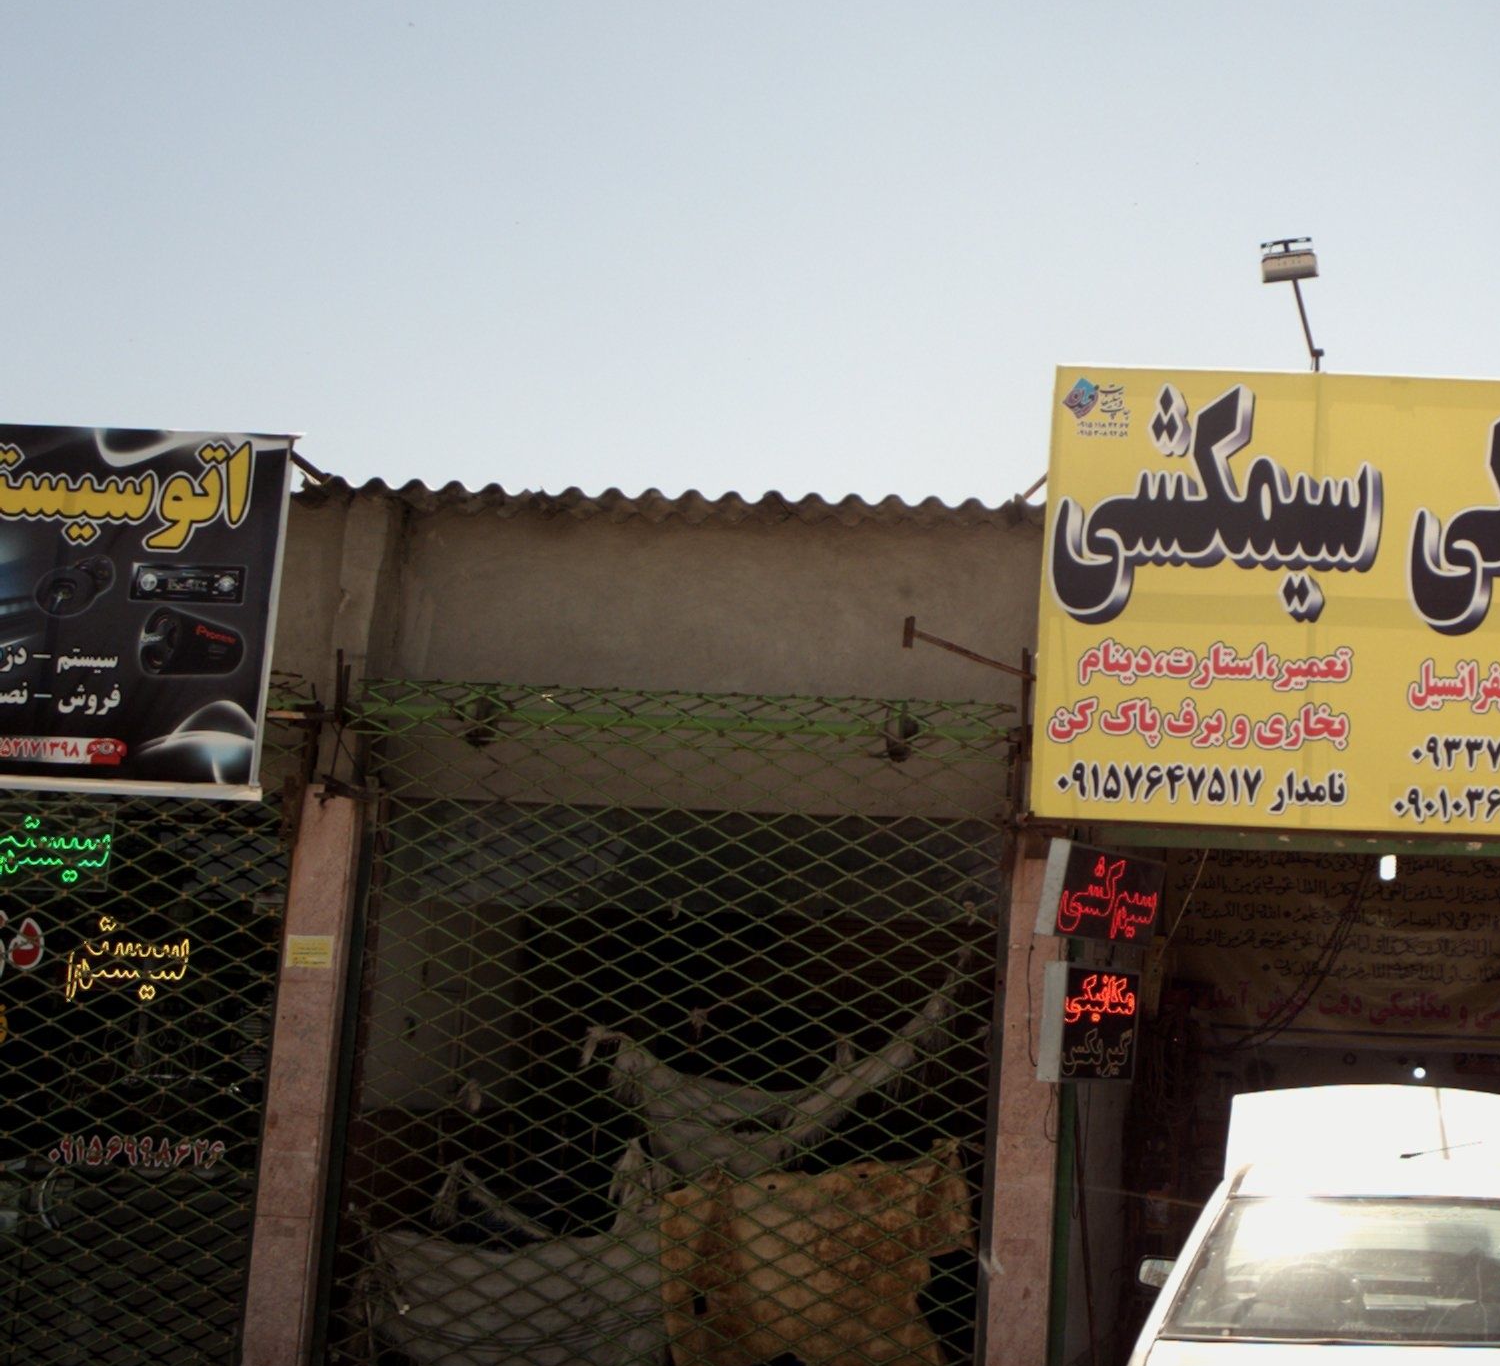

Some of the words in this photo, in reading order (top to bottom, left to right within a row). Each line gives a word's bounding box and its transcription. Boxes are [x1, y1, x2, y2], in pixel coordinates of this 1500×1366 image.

[1051, 383, 1382, 624] سیمکشی
[56, 647, 119, 673] سیستم
[58, 683, 121, 716] فروش
[1049, 697, 1098, 743] کن
[1102, 697, 1161, 748] پاک
[1164, 698, 1225, 747] برف
[1227, 713, 1250, 747] و
[1254, 704, 1349, 750] بخاری
[1056, 760, 1262, 803] ۰۹۱۵۷۶۴۷۵۱۷
[1268, 769, 1347, 814] نامدار
